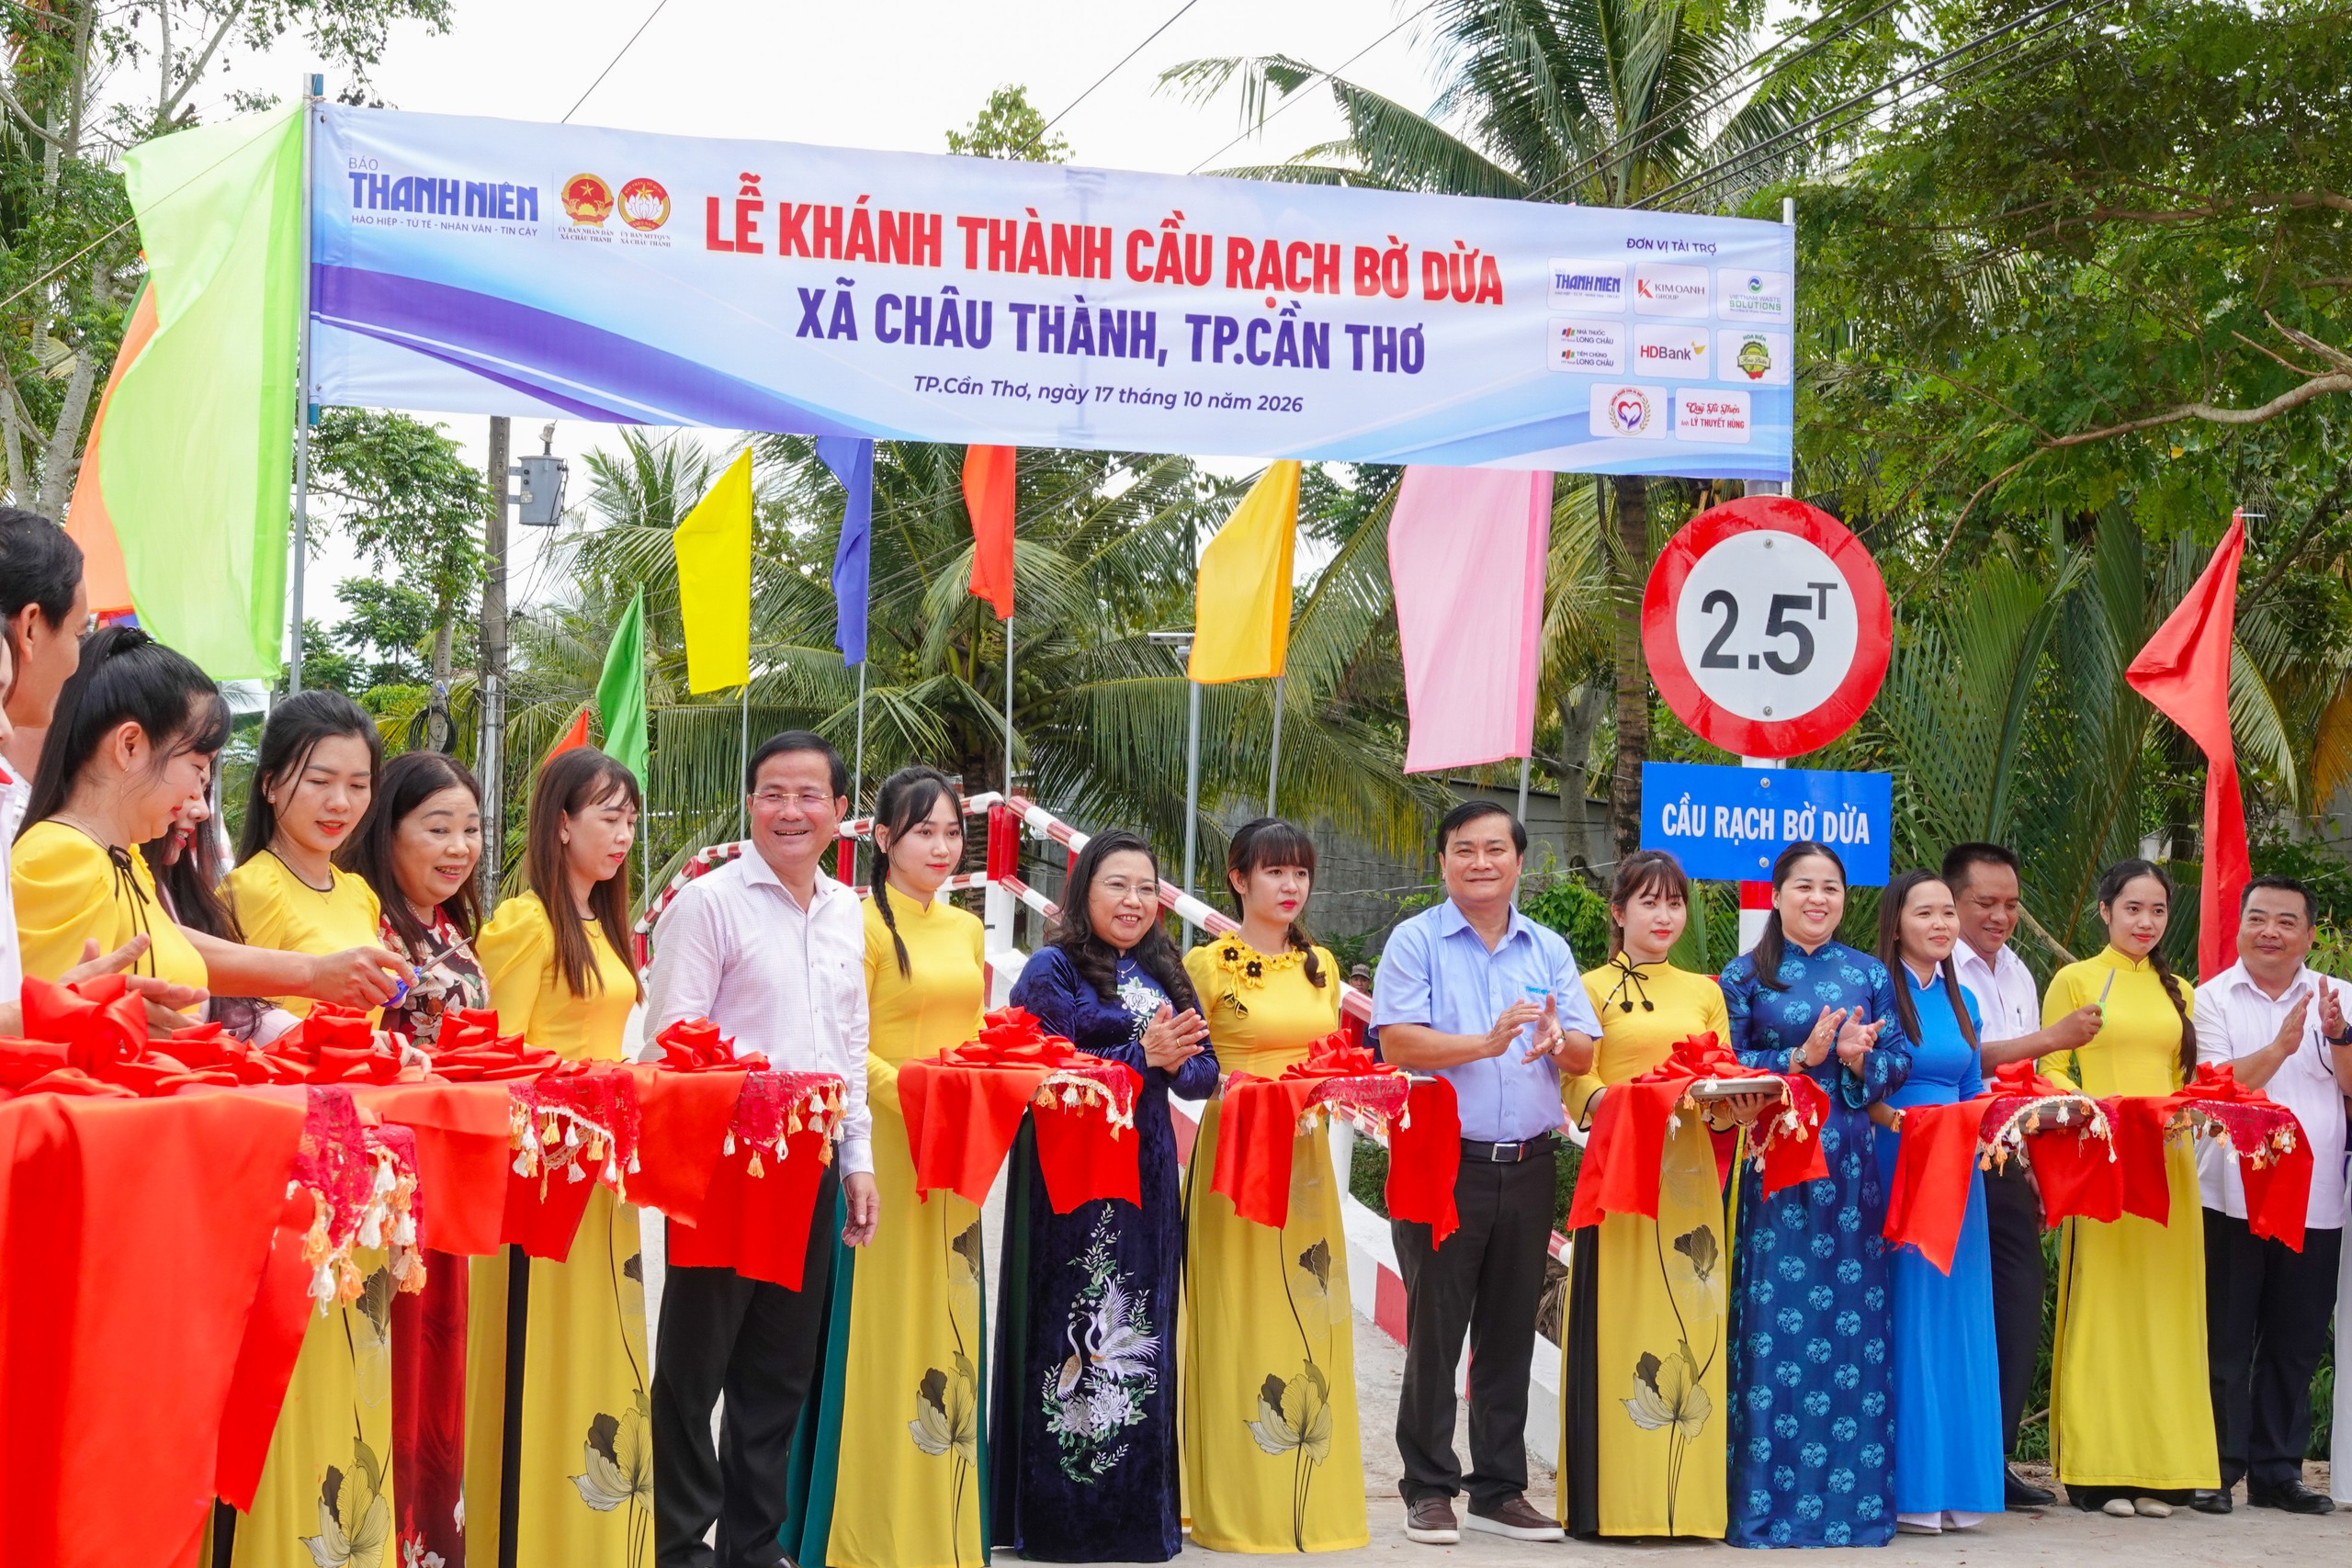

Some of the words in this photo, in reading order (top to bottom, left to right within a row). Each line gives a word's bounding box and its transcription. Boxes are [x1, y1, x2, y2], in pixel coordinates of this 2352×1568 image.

[348, 156, 379, 171] BÁO
[348, 171, 460, 216] THANH
[464, 180, 538, 222] NIÊN
[376, 217, 398, 228] HIỆP
[406, 217, 420, 228] TỬ
[501, 227, 516, 235] TIN
[706, 172, 764, 254] LỄ
[779, 195, 943, 267] KHÁNH
[956, 208, 1112, 281] THÀNH
[1126, 210, 1213, 287] CẦU
[1227, 235, 1341, 309] RẠCH
[1355, 235, 1408, 299] BỜ
[1421, 240, 1504, 306] DỪA
[1626, 237, 1654, 250] ĐƠN
[1657, 240, 1668, 254] VỊ
[1671, 239, 1689, 252] TÀI
[1692, 243, 1717, 256] TRỢ
[1555, 274, 1594, 291] THANH
[1594, 276, 1621, 293] NIÊN
[1655, 283, 1674, 293] KIM
[1675, 285, 1705, 295] OANH
[1729, 299, 1781, 311] SOLUTIONS
[796, 276, 858, 342] XÃ
[875, 286, 992, 351] CHÂU
[1009, 295, 1169, 367] THÀNH,
[1185, 300, 1330, 369] TP.CẦN
[1343, 321, 1426, 375] THƠ
[1640, 344, 1691, 361] HDBank
[1576, 358, 1595, 367] LONG
[913, 375, 983, 395] TP.Cần
[990, 380, 1033, 402] Thơ,
[1037, 385, 1089, 405] ngày
[1094, 386, 1114, 402] 17
[1118, 388, 1177, 410] tháng
[1182, 391, 1203, 406] 10
[1208, 392, 1252, 409] năm
[1257, 394, 1304, 412] 2026
[1700, 589, 1815, 676] 2.5
[1662, 792, 1706, 838] CẦU
[1714, 807, 1775, 845] RẠCH
[1783, 801, 1818, 842] BỜ
[1823, 802, 1871, 844] DỪA
